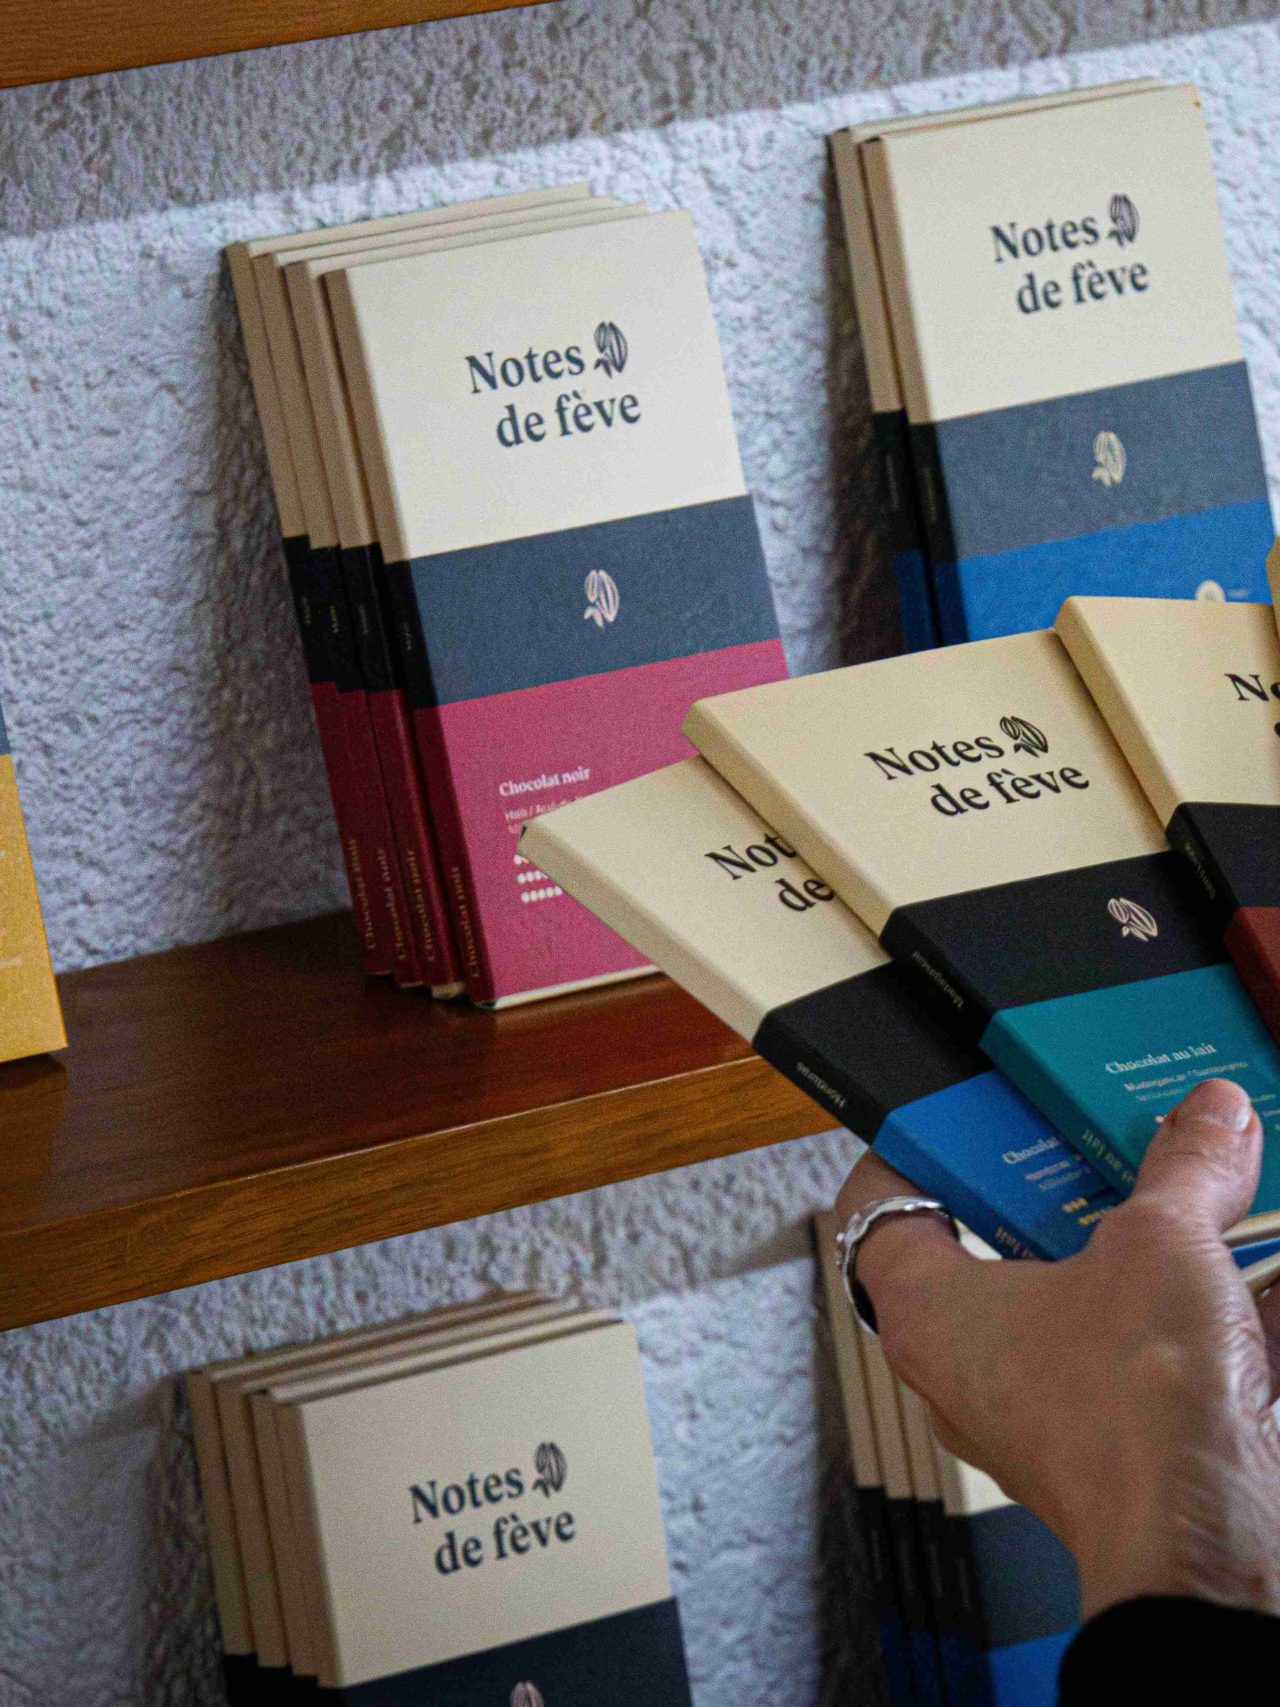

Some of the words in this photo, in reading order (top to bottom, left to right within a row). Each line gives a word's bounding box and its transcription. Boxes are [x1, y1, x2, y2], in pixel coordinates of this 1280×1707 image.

[990, 215, 1100, 263] Notes
[1016, 272, 1062, 315] de
[1071, 258, 1150, 304] fève
[464, 346, 586, 394] Notes
[496, 403, 546, 448] de
[555, 390, 641, 437] fève
[499, 773, 560, 796] Chocolat
[561, 764, 590, 784] noir
[863, 736, 1005, 781] Notes
[930, 783, 990, 816] de
[986, 767, 1090, 804] fève
[704, 833, 798, 880] Not
[774, 877, 835, 912] de
[1105, 1054, 1171, 1074] Chocolat
[408, 1467, 525, 1524] Notes
[434, 1530, 484, 1576] de
[493, 1511, 576, 1560] fève
